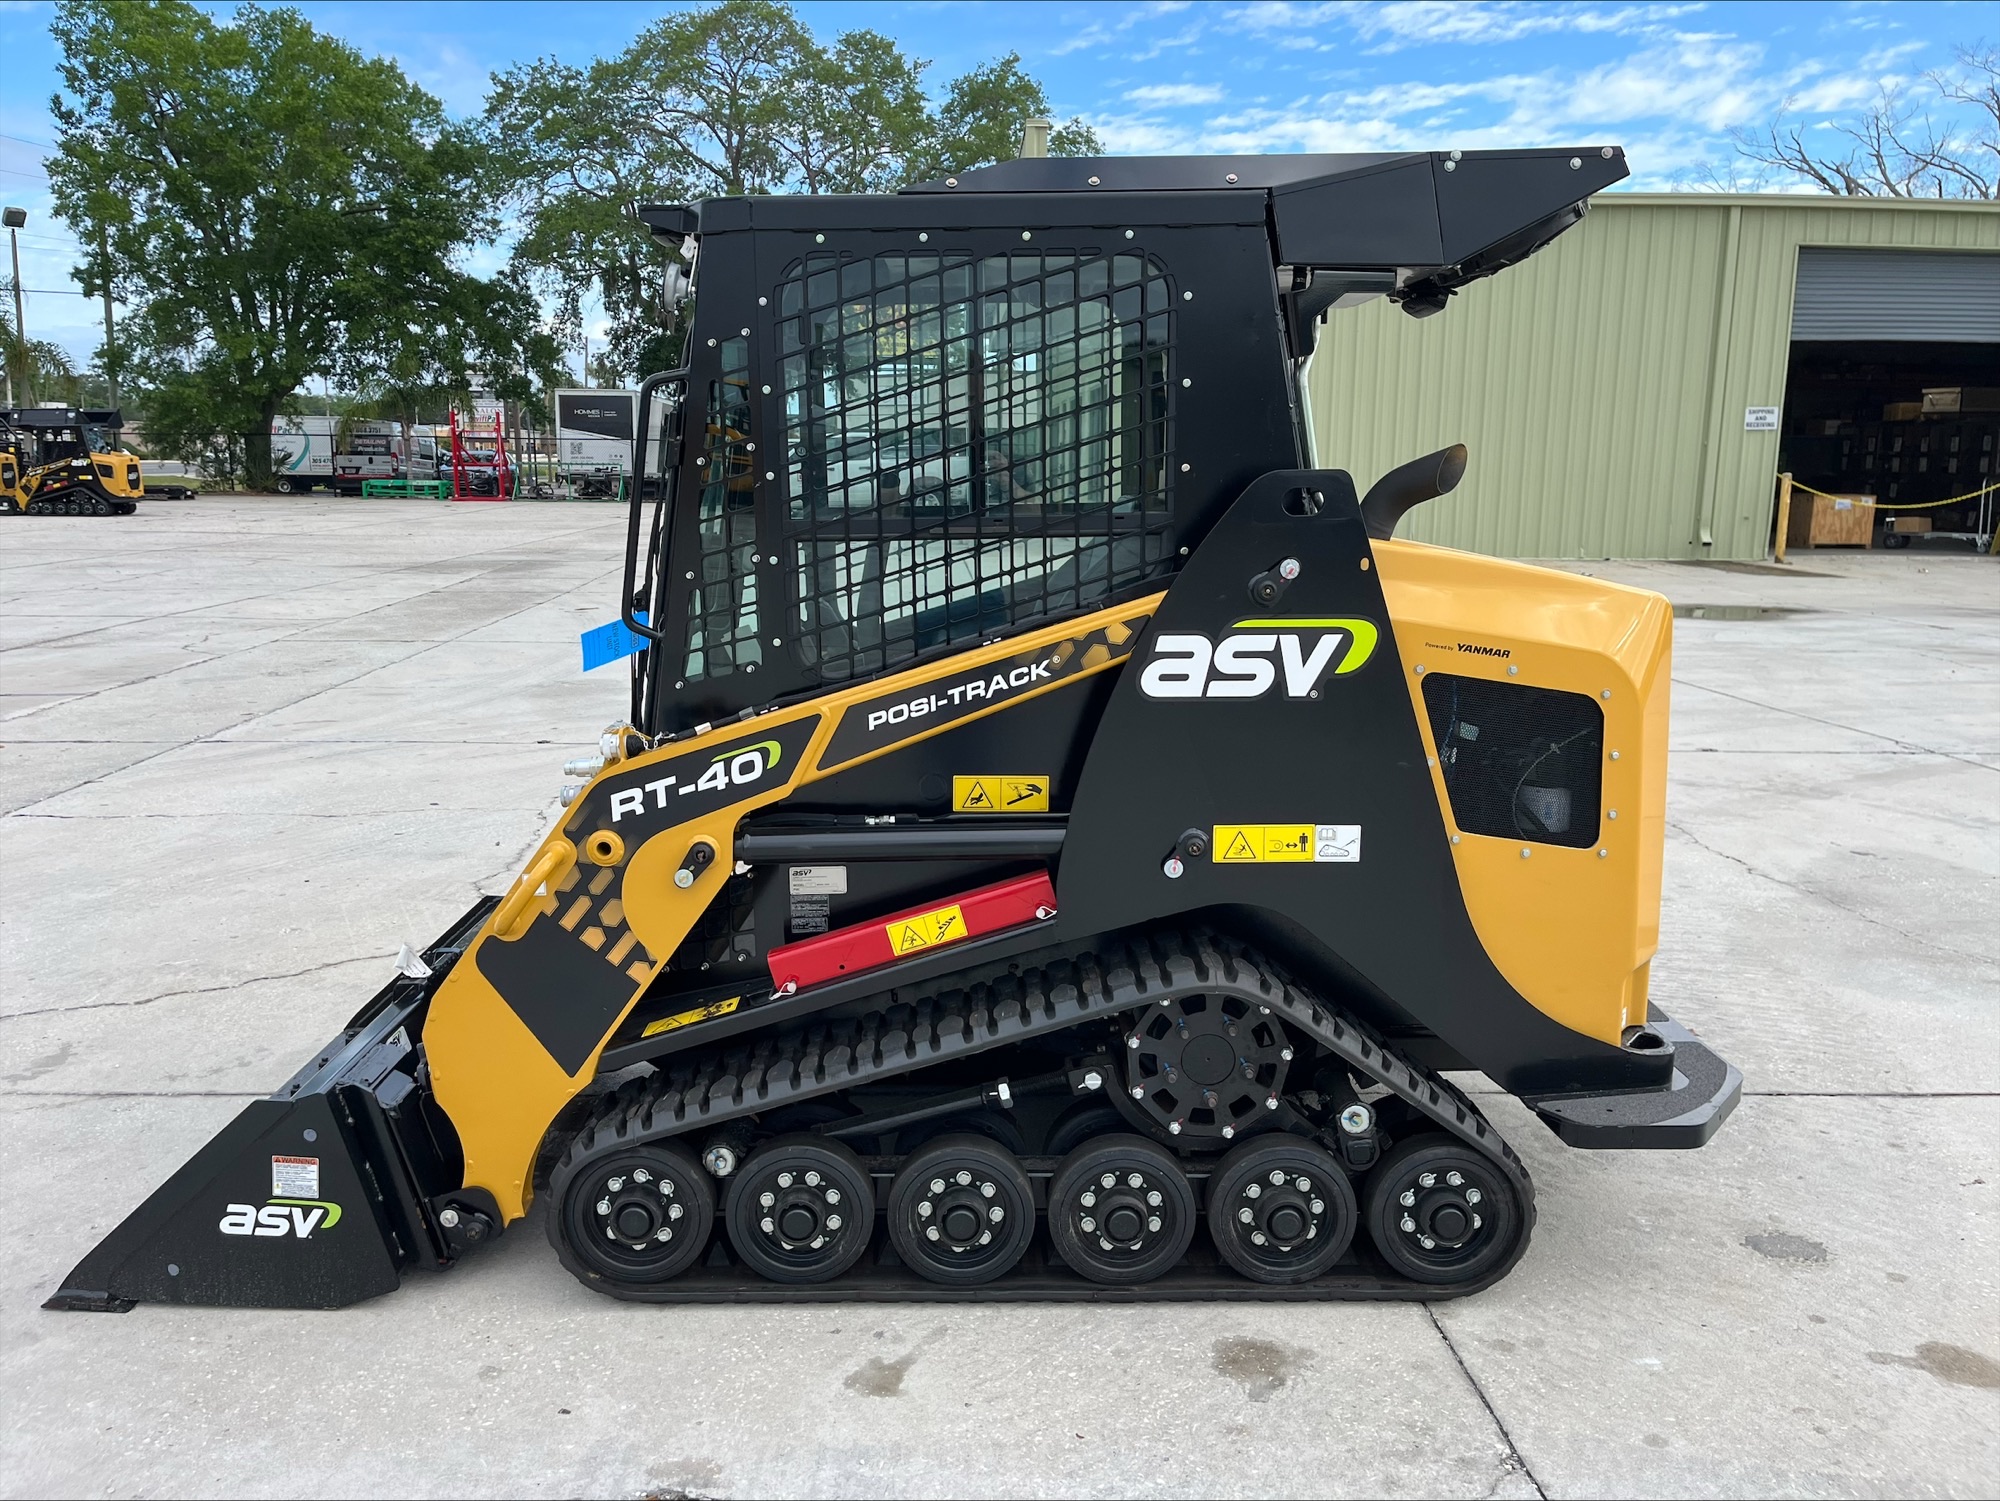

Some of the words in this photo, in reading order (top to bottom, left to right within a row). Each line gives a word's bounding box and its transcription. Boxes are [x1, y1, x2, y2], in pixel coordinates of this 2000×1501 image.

[1425, 642, 1448, 650] Powered
[1457, 643, 1511, 659] YANMAR
[610, 751, 764, 823] RT-40
